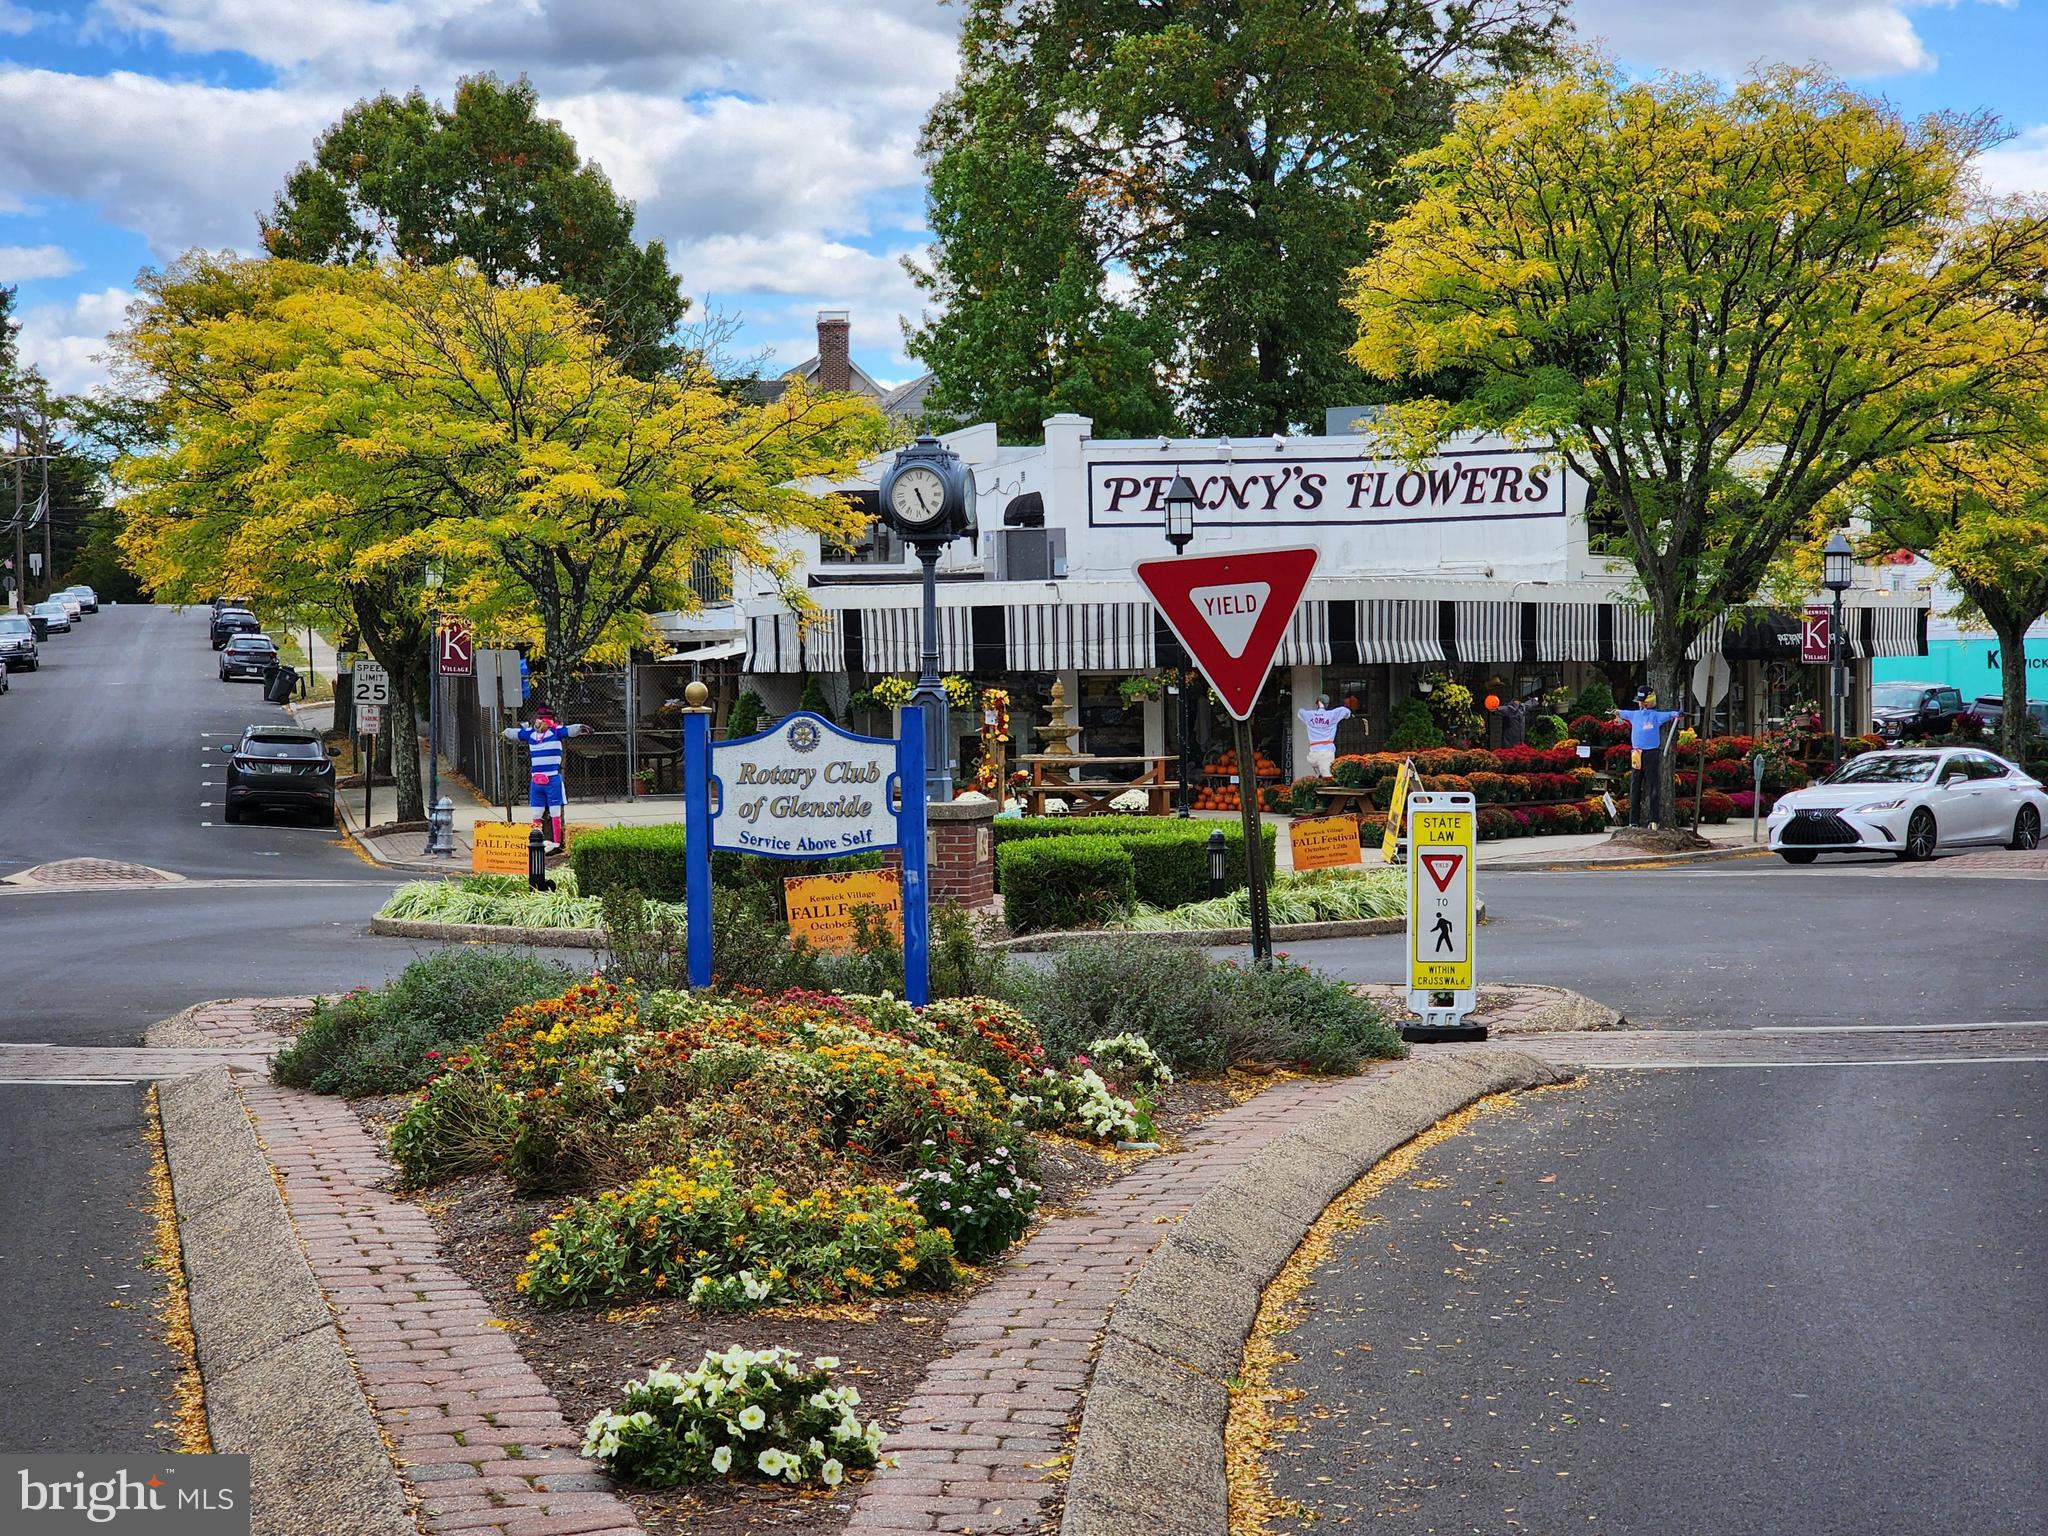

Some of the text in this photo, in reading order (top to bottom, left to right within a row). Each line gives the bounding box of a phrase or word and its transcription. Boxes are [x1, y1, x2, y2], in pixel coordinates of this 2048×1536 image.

[1103, 461, 1551, 512] PENNY'S FLOWERS
[1204, 594, 1257, 616] YIELD
[1805, 619, 1827, 649] K
[442, 629, 472, 660] K
[356, 684, 386, 700] 25
[736, 760, 881, 790] Rotary Club
[738, 795, 872, 824] of Glenside
[1423, 817, 1461, 829] STATE
[475, 839, 527, 850] FALL Festi
[739, 828, 873, 851] Service Above Self
[1293, 832, 1358, 848] FALL Festival
[1429, 831, 1455, 842] LAW
[809, 891, 876, 903] Keswick Village
[1436, 898, 1448, 907] TO
[791, 905, 836, 920] FALL
[810, 920, 854, 931] October
[1428, 965, 1456, 974] WITHIN
